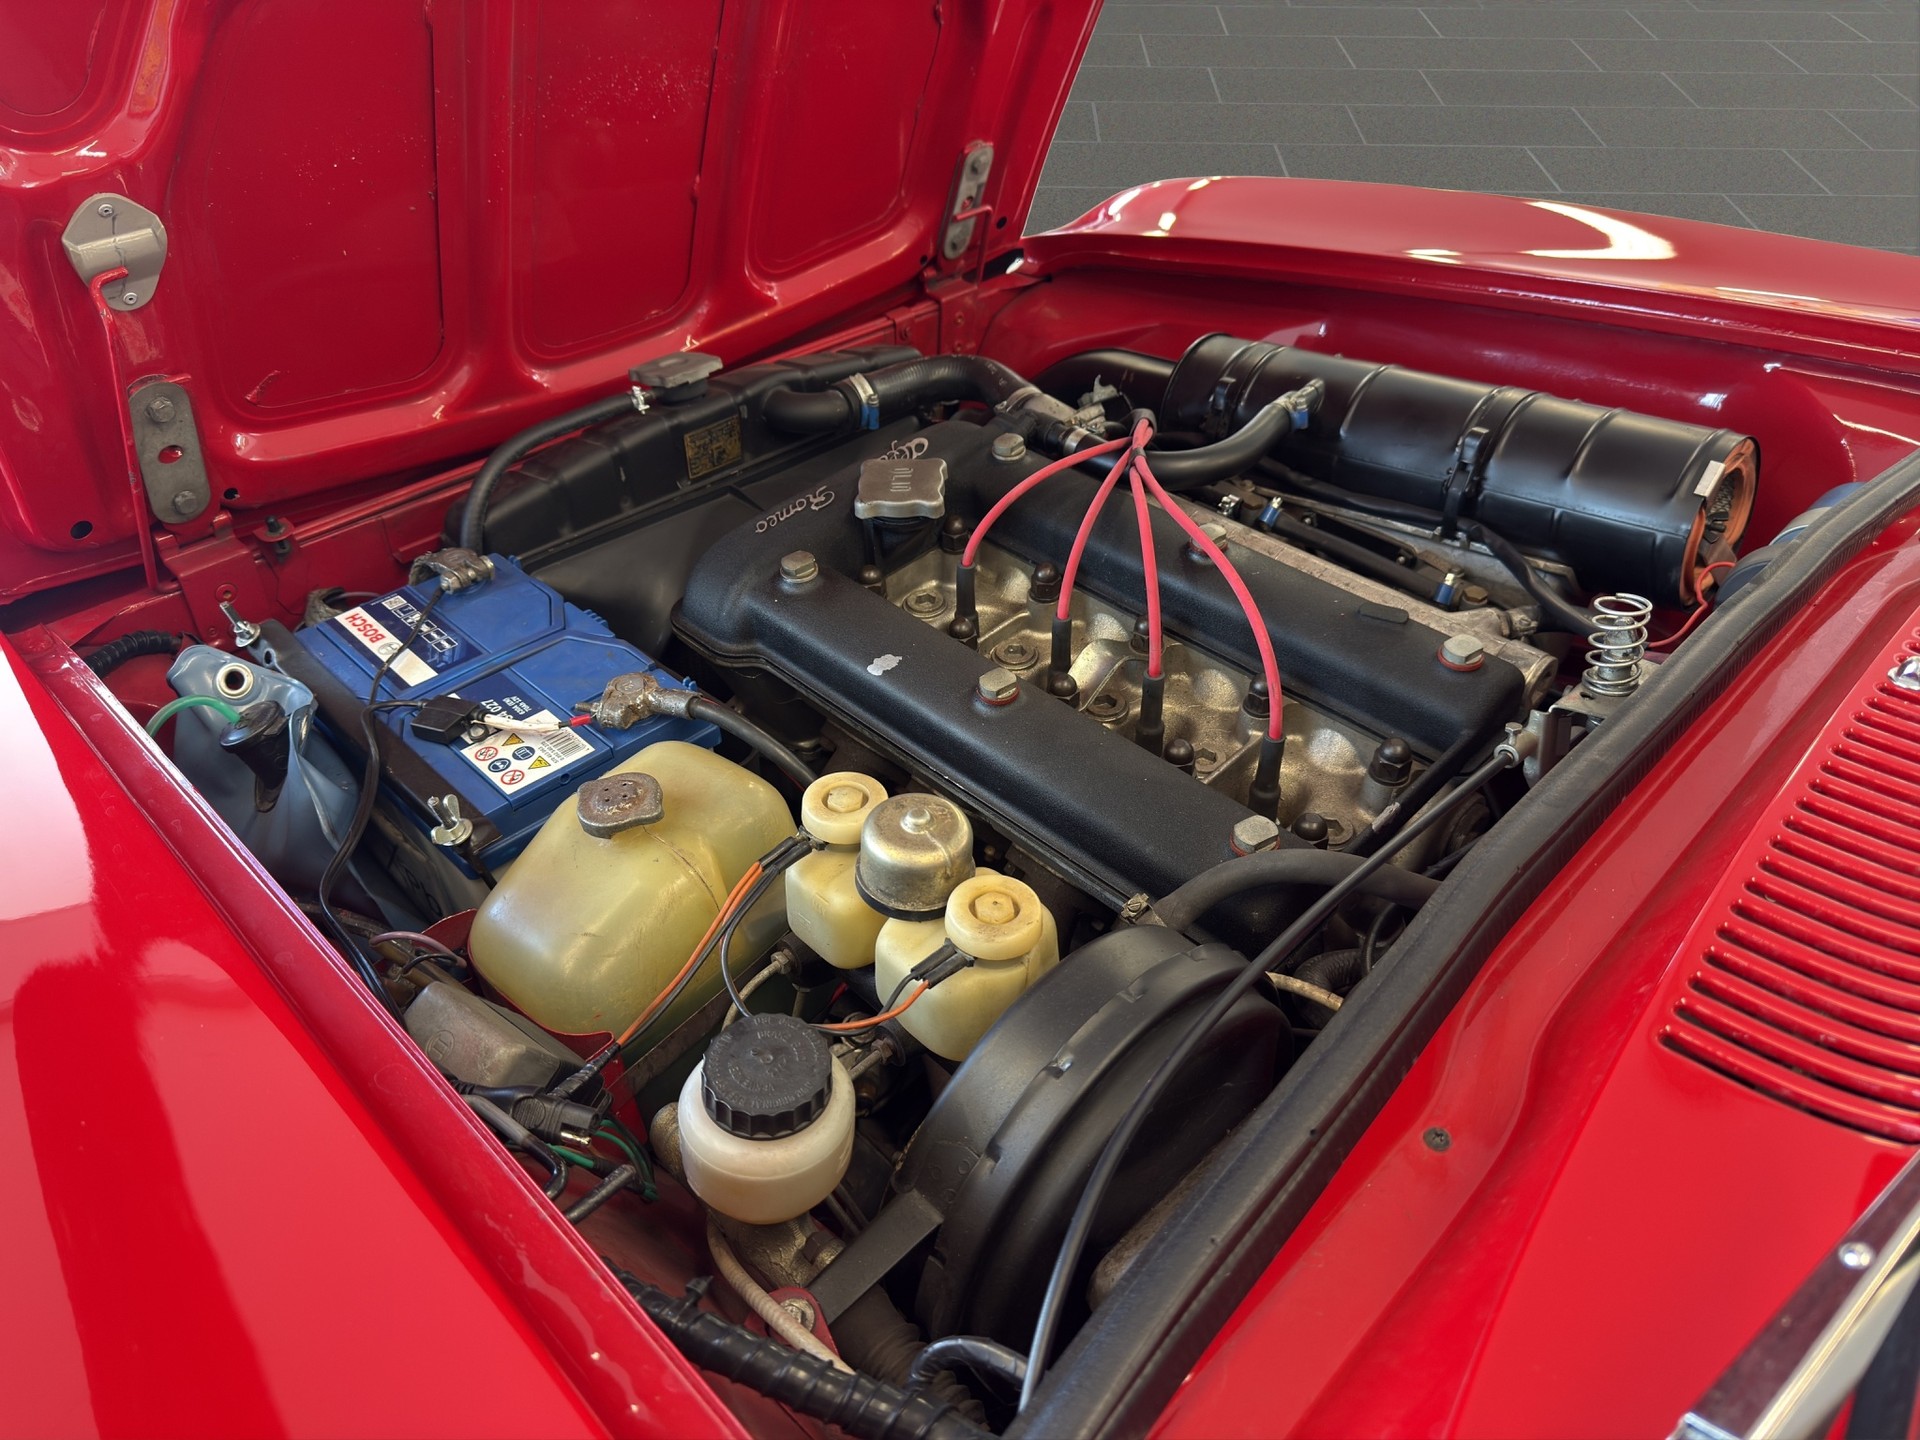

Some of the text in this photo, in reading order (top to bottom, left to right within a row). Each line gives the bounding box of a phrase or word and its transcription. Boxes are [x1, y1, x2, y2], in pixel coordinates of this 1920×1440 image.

[755, 438, 928, 533] Alf Romeo
[345, 613, 386, 643] BOSCH
[480, 699, 501, 712] 027
